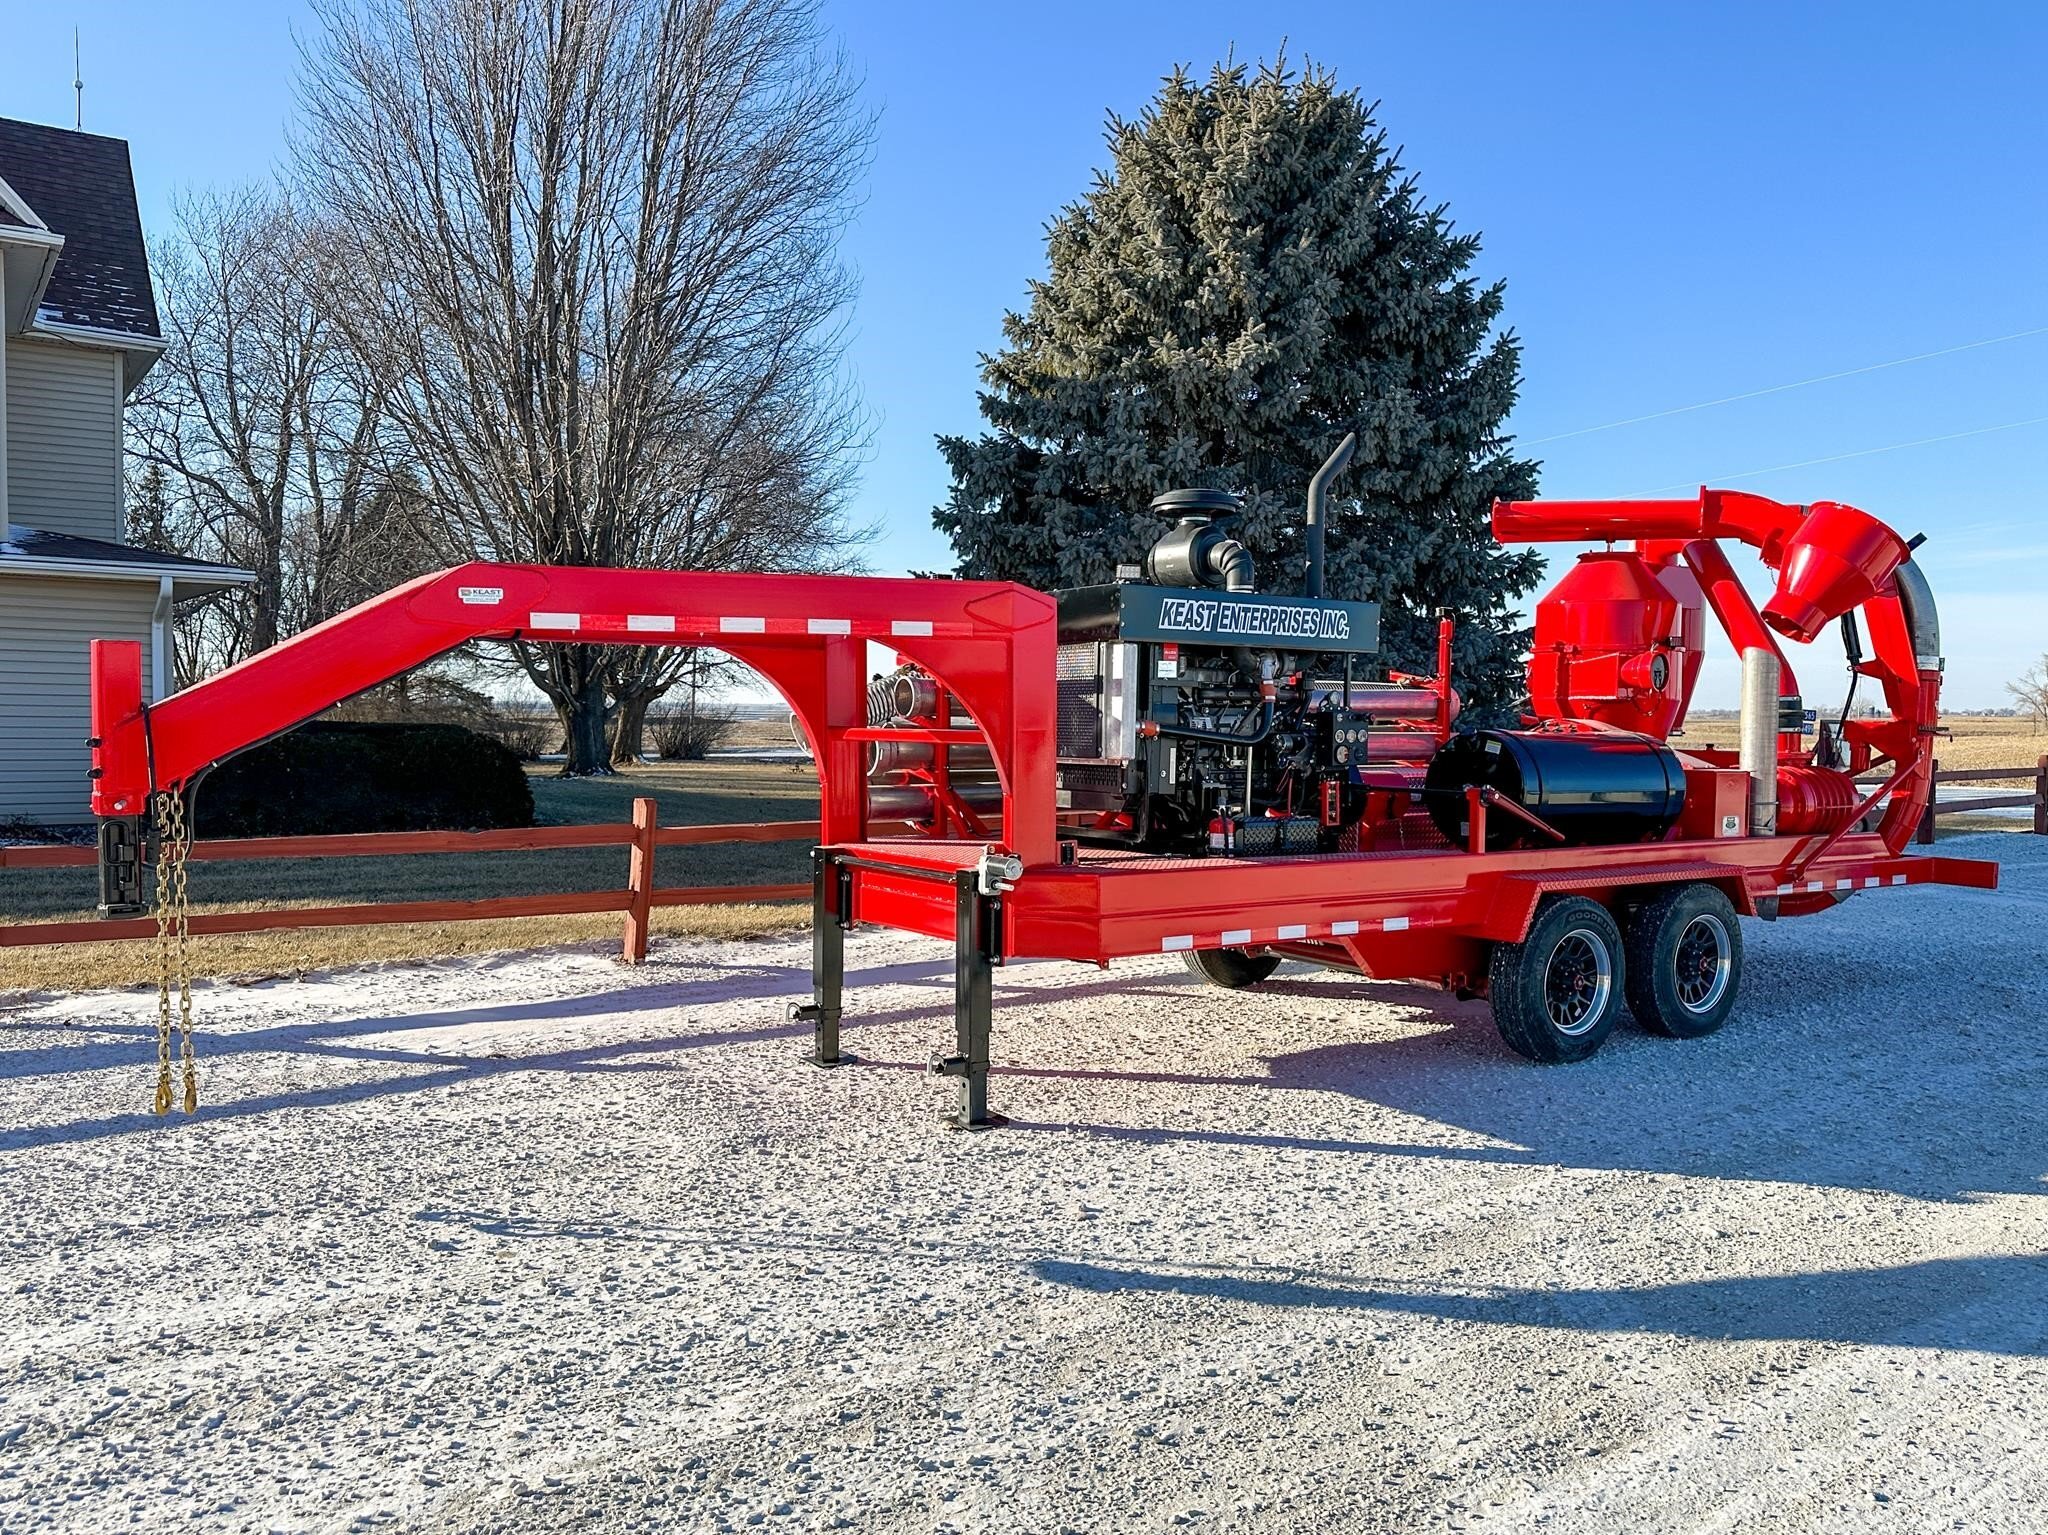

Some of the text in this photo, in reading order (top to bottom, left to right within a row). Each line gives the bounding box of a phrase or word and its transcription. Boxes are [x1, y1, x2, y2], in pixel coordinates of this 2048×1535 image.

[1159, 598, 1350, 639] KEAST ENTERPRISES INC.
